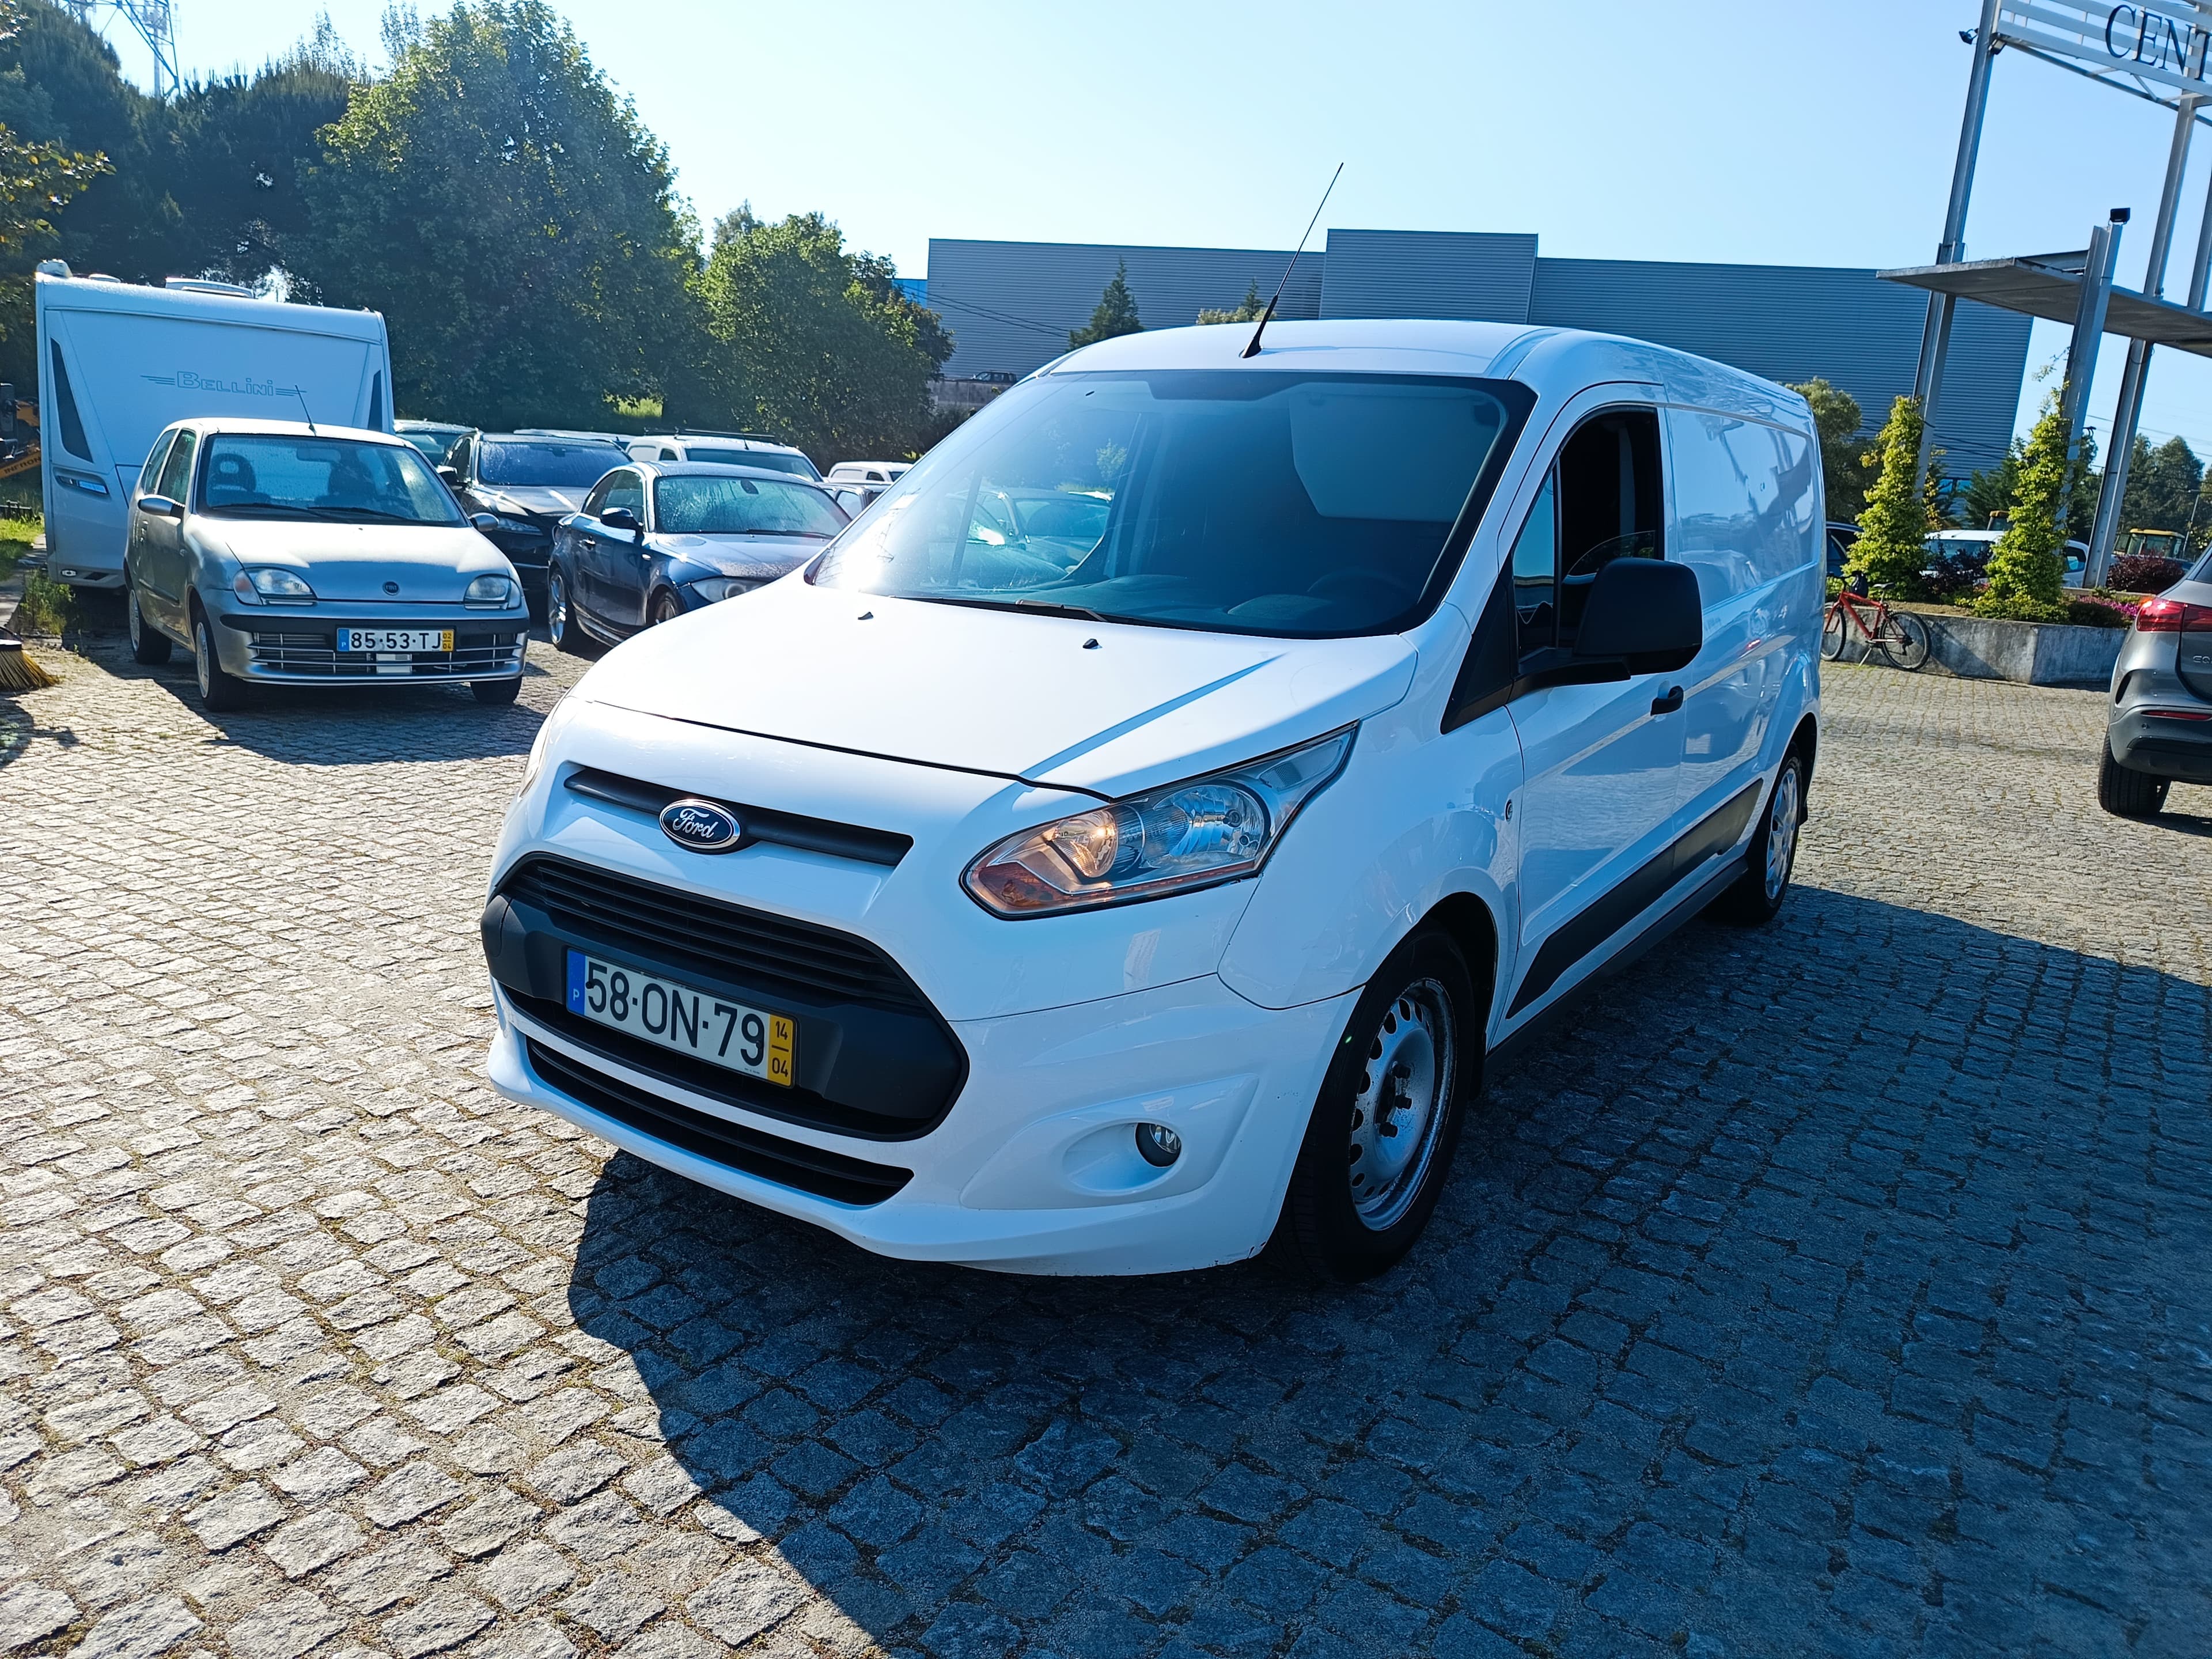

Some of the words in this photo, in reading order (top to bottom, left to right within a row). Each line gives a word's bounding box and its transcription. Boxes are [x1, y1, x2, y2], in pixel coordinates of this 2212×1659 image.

[2105, 5, 2212, 82] CENT
[2193, 656, 2212, 664] EQ
[673, 808, 718, 838] Ford
[573, 988, 579, 1001] P
[775, 1021, 788, 1040] 14
[772, 1058, 788, 1077] 04
